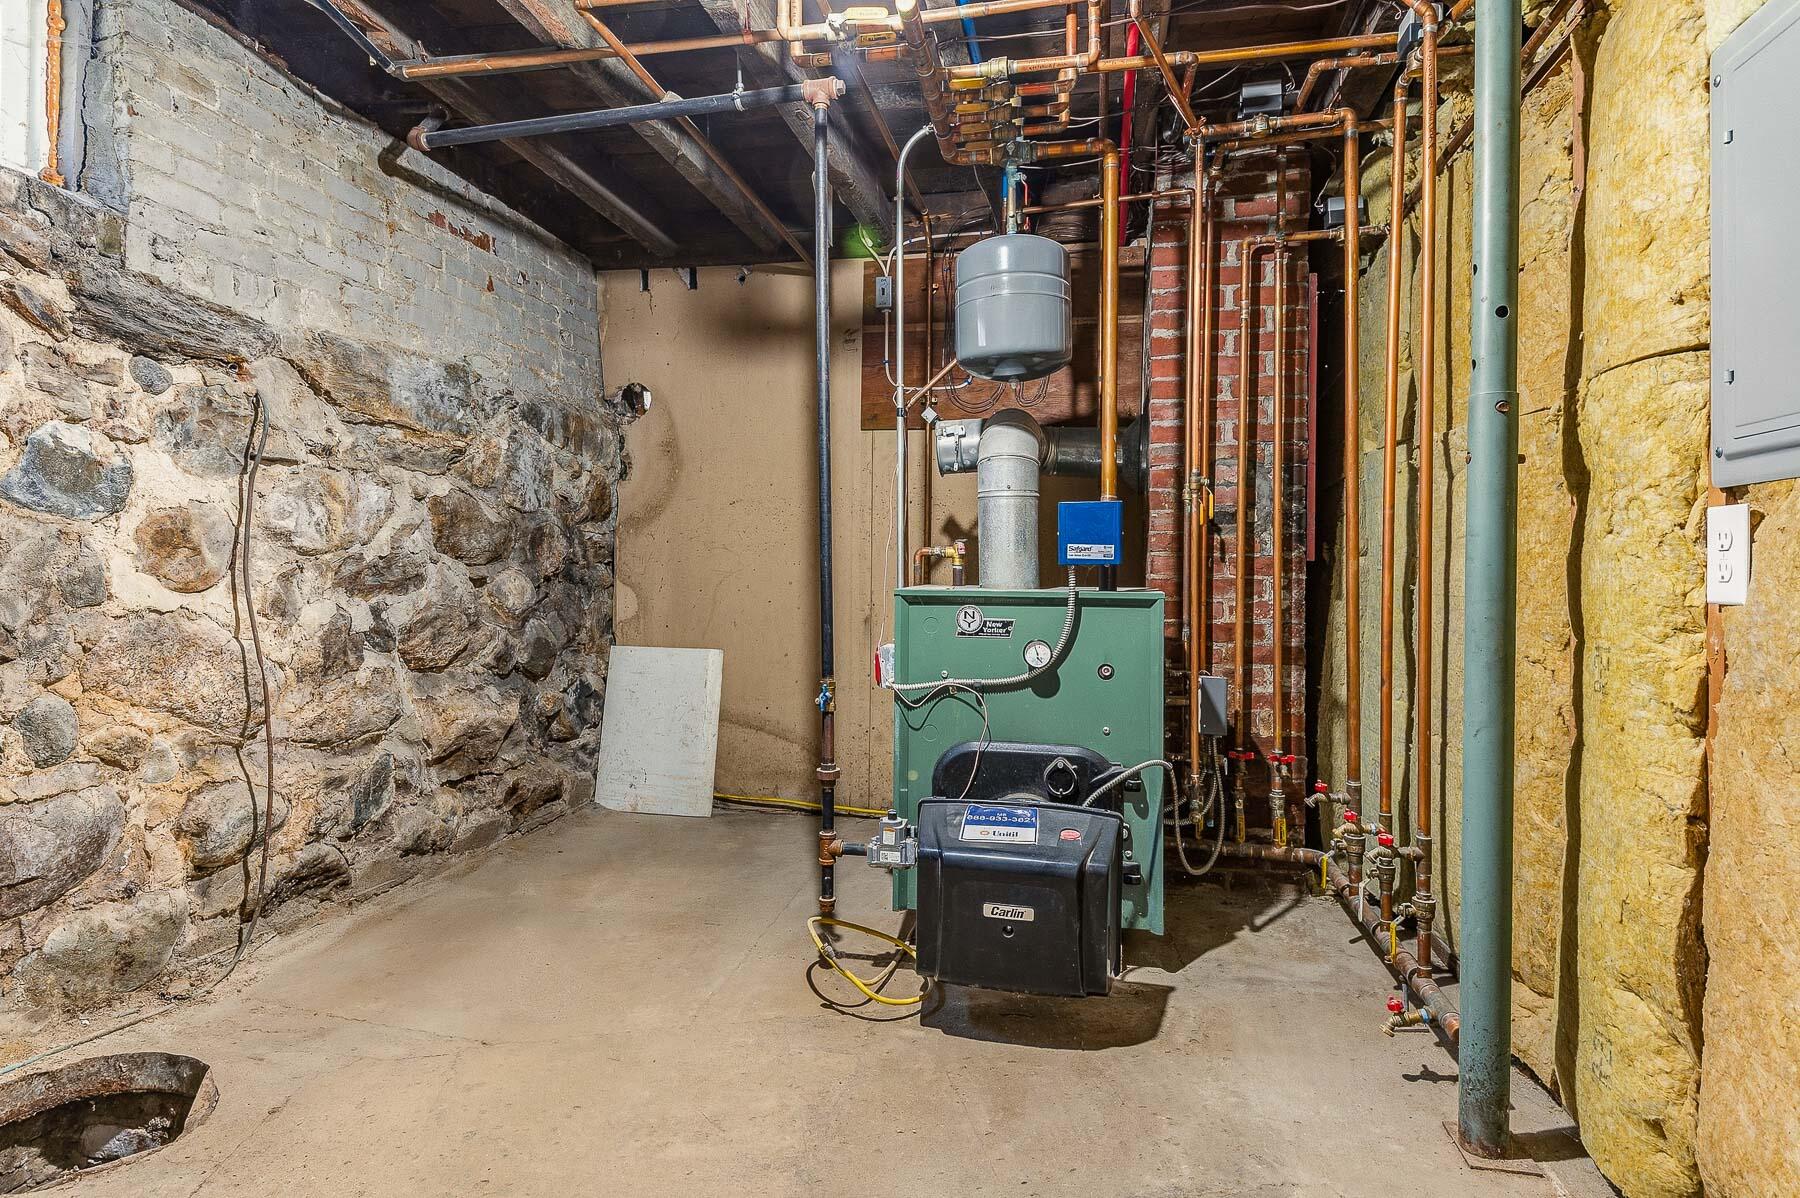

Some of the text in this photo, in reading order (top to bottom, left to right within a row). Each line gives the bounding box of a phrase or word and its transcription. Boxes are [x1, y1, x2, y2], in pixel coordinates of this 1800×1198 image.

[986, 620, 1003, 628] New
[982, 626, 1008, 634] Yorker
[992, 830, 1019, 838] Unitil
[990, 906, 1025, 919] Carlin
